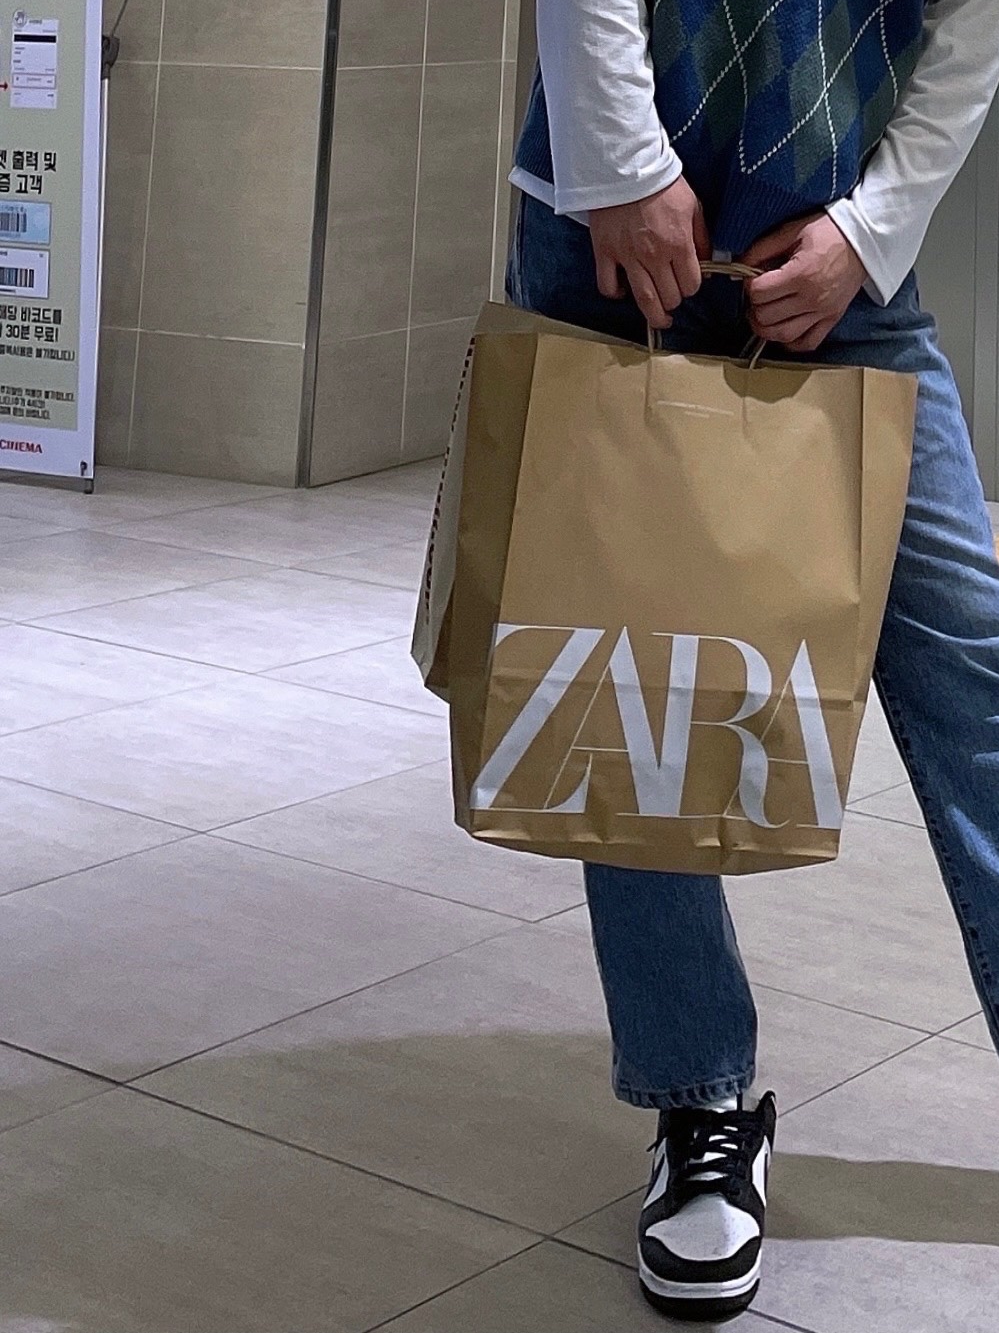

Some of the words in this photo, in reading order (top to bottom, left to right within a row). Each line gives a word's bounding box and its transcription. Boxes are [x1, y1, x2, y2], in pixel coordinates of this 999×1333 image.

[12, 150, 39, 171] 출력
[44, 152, 57, 172] 및
[15, 174, 43, 194] 고객
[21, 307, 62, 325] 바코드를
[5, 325, 31, 341] 30분
[469, 622, 845, 830] ZARA
